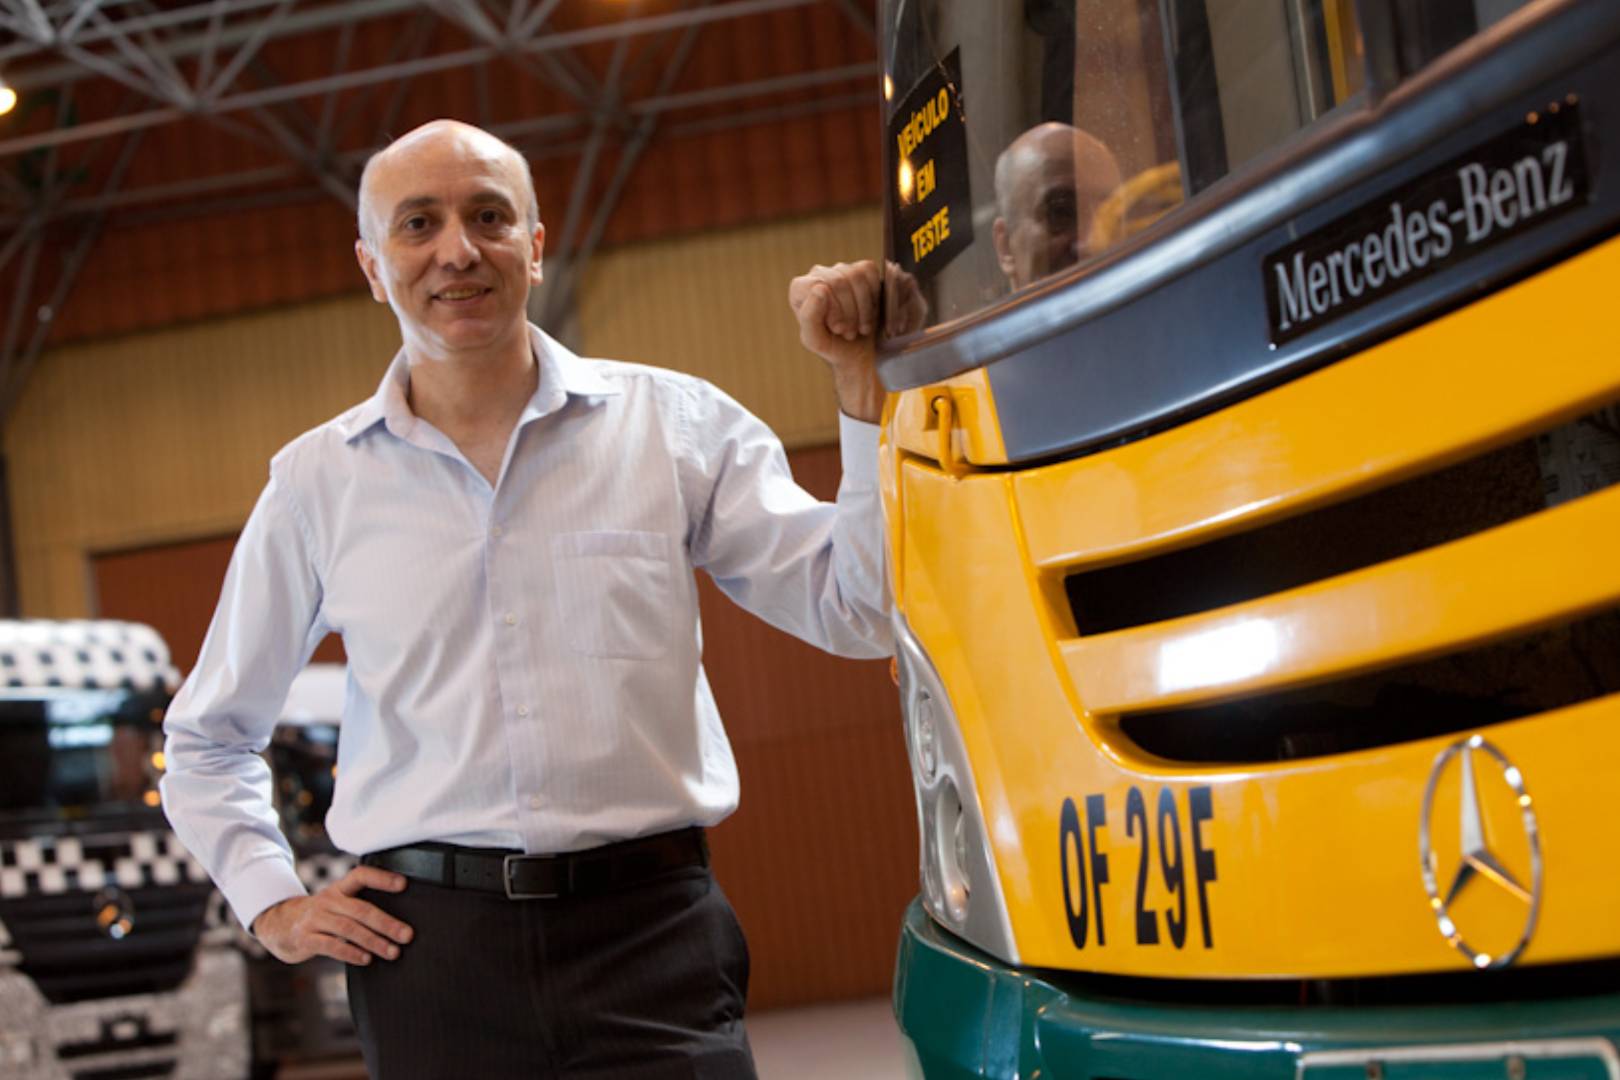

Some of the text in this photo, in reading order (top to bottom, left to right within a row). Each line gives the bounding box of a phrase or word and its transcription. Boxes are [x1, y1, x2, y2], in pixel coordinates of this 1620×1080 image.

[911, 205, 951, 263] TESTE
[915, 158, 936, 202] EM
[1274, 141, 1574, 331] Mercedes-Benz
[1060, 784, 1218, 950] OF 29F
